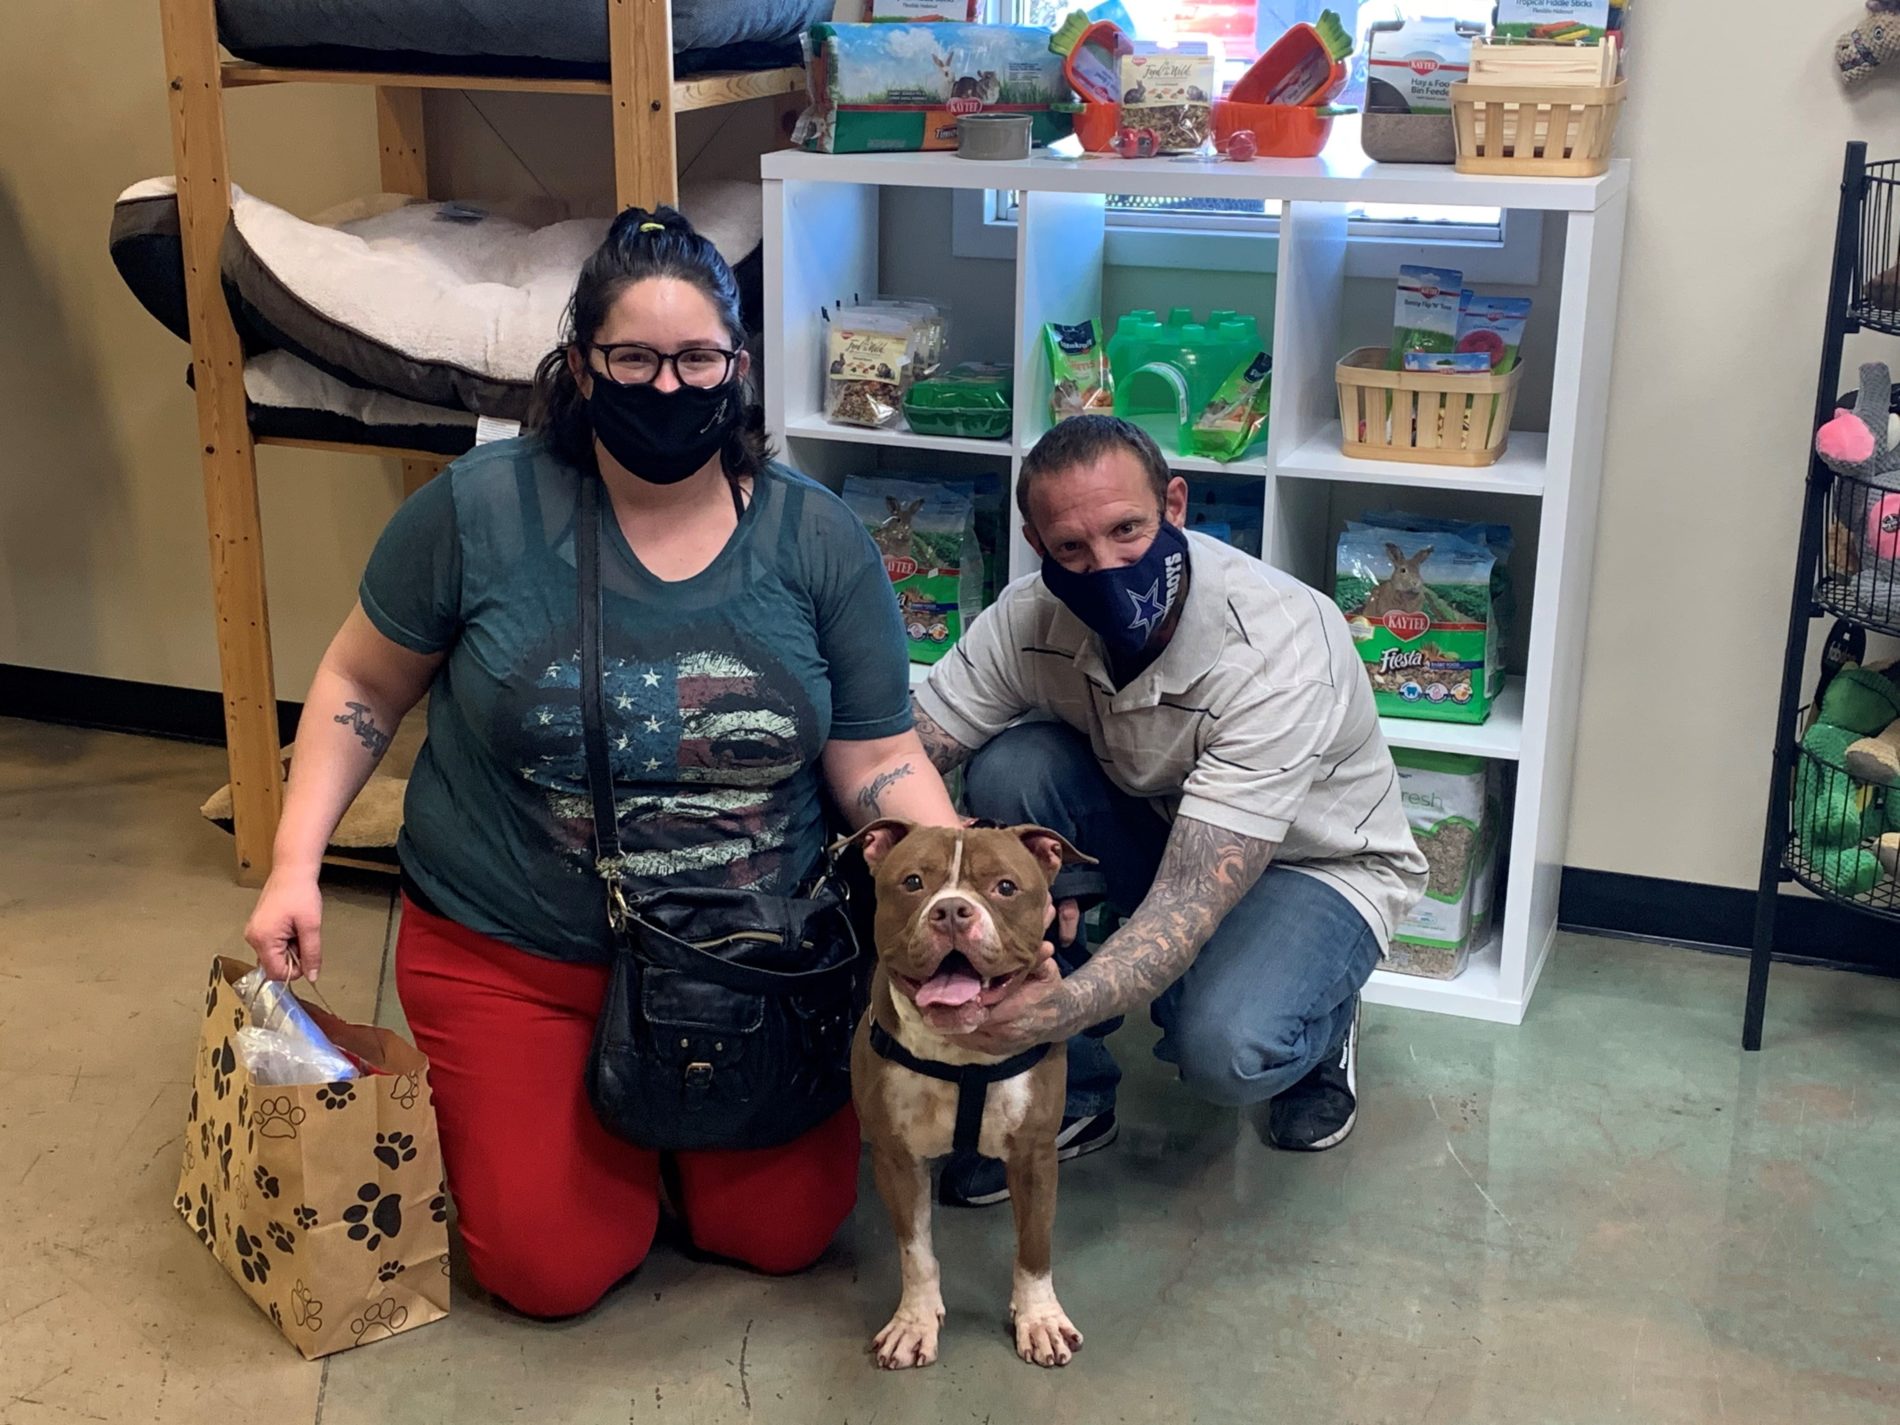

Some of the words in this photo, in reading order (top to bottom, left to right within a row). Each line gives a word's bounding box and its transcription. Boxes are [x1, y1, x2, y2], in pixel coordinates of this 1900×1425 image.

[1411, 78, 1427, 88] Hay
[1435, 80, 1450, 89] Foo
[1411, 87, 1425, 95] Bin
[1426, 87, 1449, 98] Feede
[1388, 615, 1426, 631] KAYTEE
[1380, 647, 1423, 673] Fiesta
[1401, 791, 1444, 810] resh
